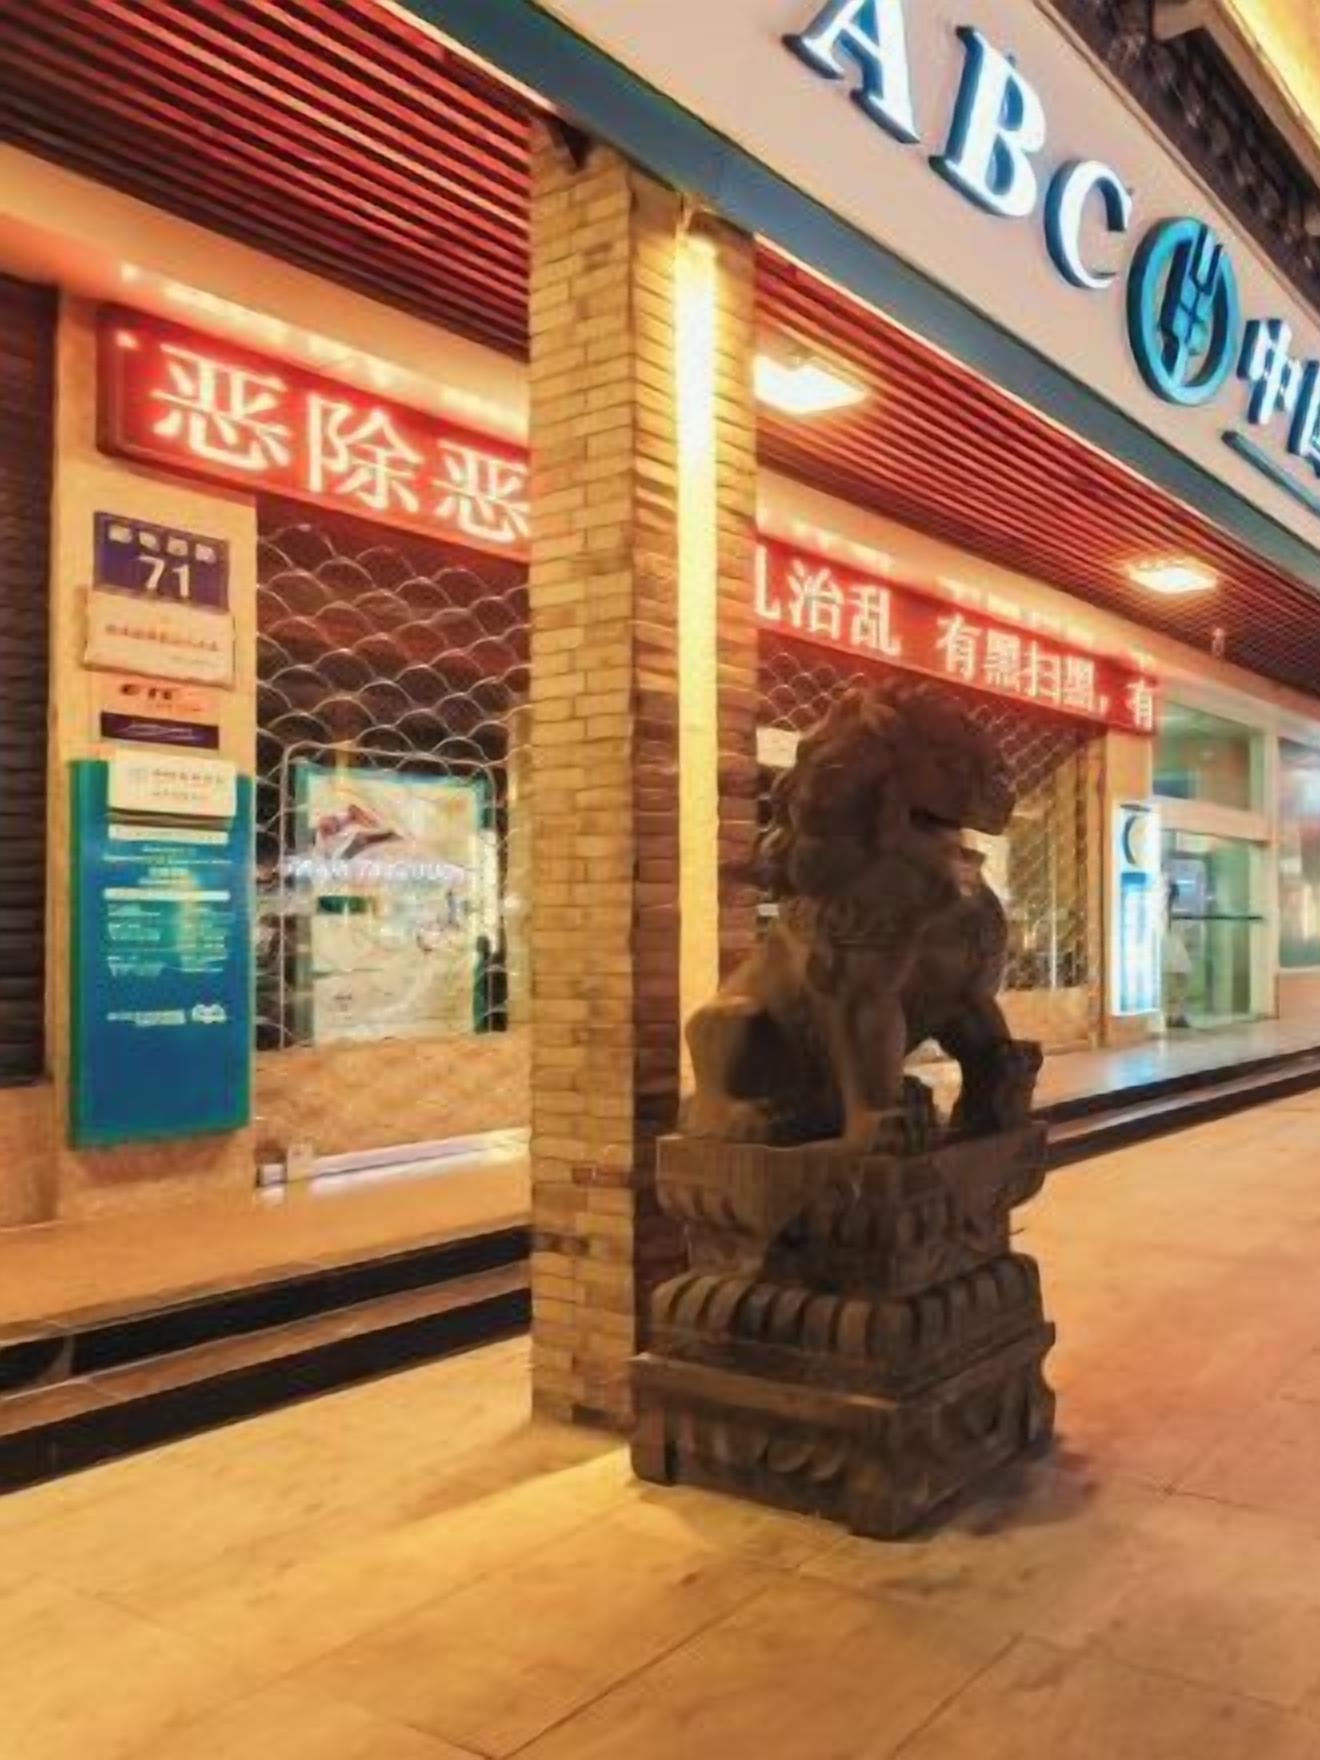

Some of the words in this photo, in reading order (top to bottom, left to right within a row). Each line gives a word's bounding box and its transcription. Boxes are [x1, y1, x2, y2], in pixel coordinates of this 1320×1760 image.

[781, 0, 1133, 290] ABC
[150, 342, 529, 544] 恶除恶
[137, 553, 191, 598] 71
